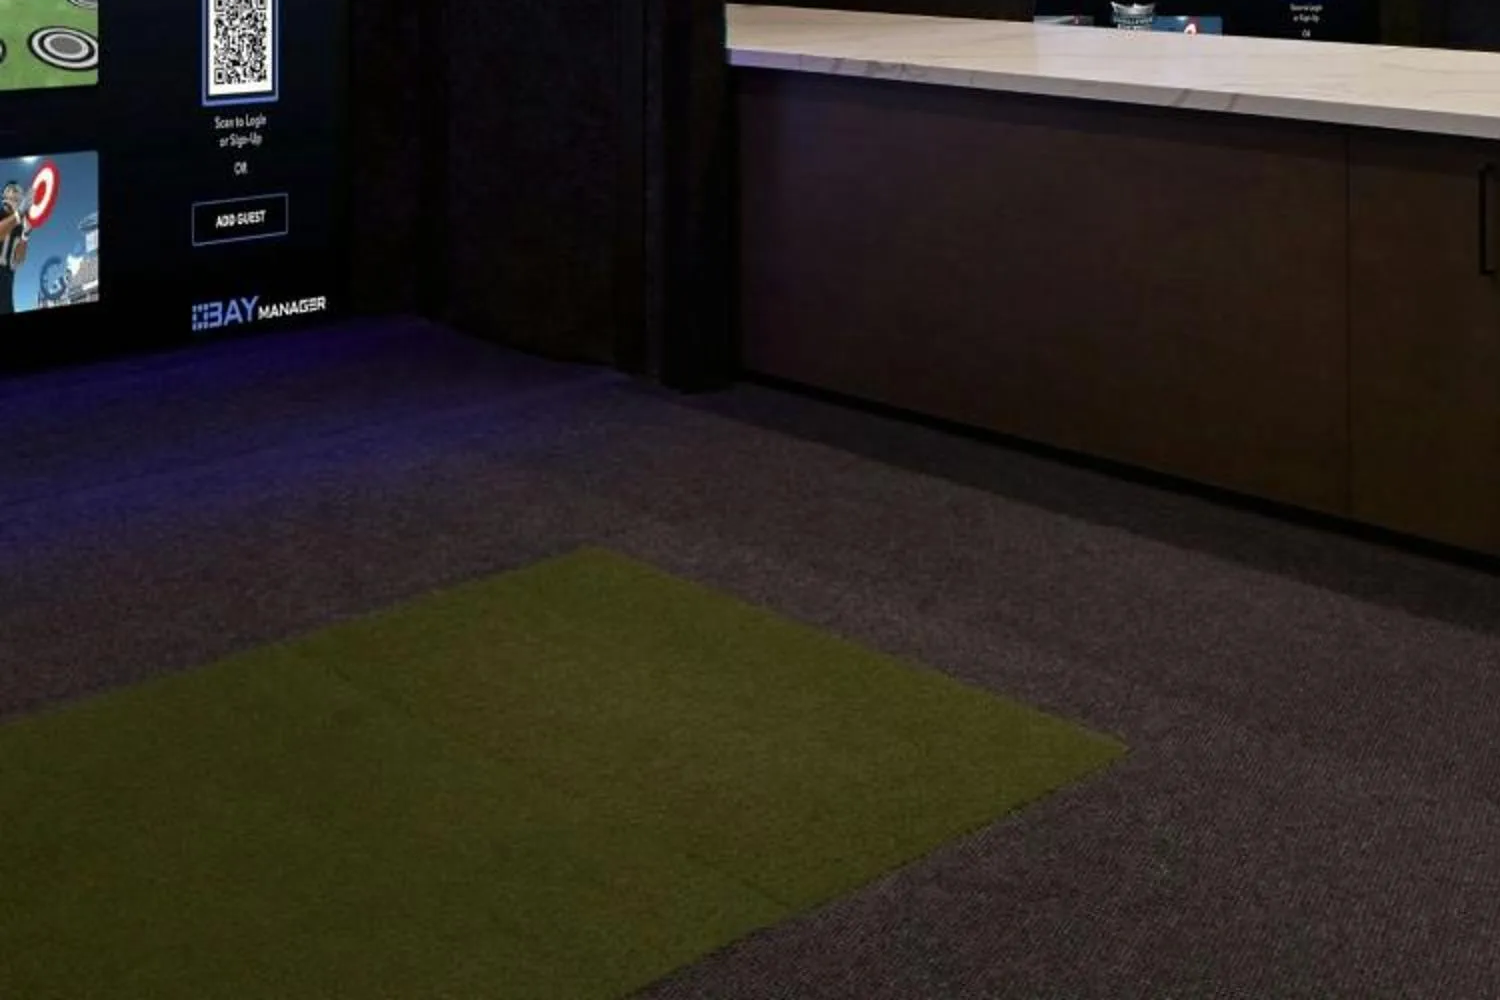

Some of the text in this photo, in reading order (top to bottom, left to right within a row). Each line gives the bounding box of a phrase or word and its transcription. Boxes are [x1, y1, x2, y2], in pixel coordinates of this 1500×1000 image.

[215, 209, 267, 228] ADD GUEST
[191, 295, 327, 331] BAY MANAGER
